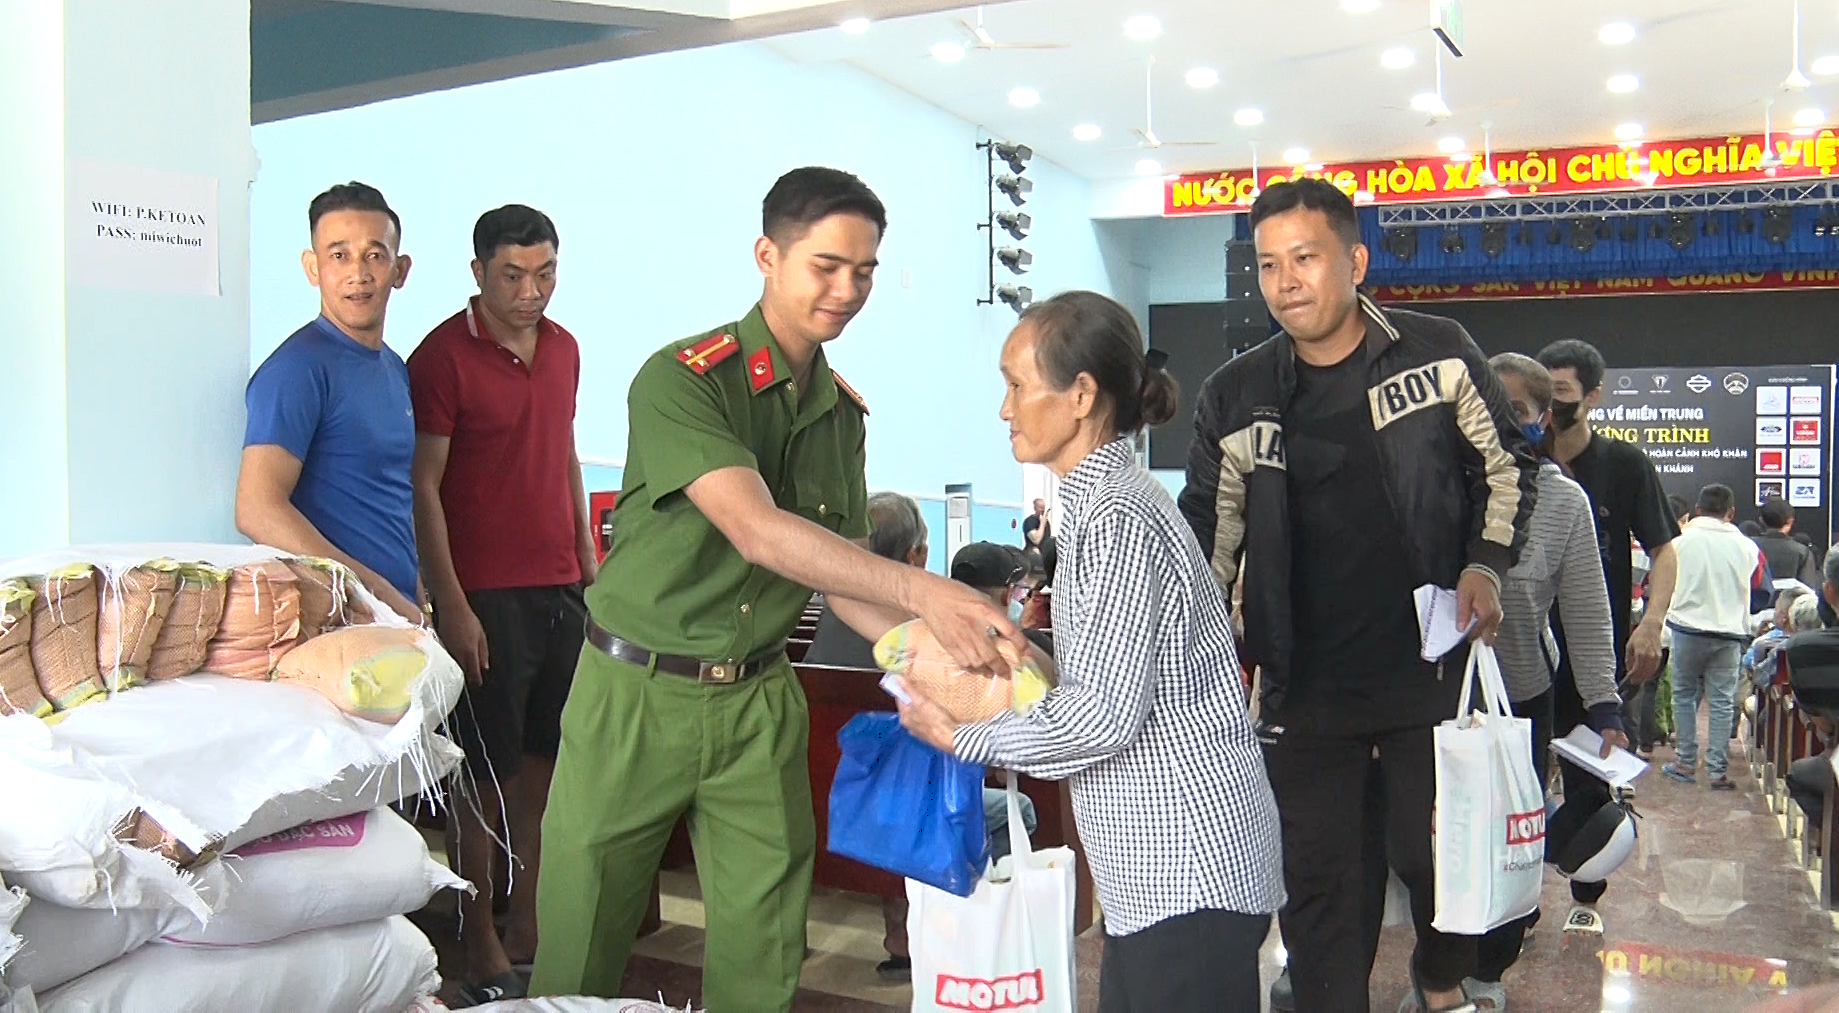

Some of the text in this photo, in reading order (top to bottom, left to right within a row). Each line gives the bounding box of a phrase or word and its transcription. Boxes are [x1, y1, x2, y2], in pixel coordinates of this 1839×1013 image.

[1366, 160, 1436, 193] HÒA
[1443, 154, 1488, 190] XÃ
[1497, 151, 1557, 193] HỘI
[1649, 135, 1765, 177] NGHĨA
[1774, 130, 1839, 176] VIỆ
[91, 201, 206, 226] WIFI: P.KETOAN
[96, 224, 202, 247] PASS: miwichuot
[1660, 407, 1704, 421] TRUNG
[1643, 424, 1710, 444] TRÌNH
